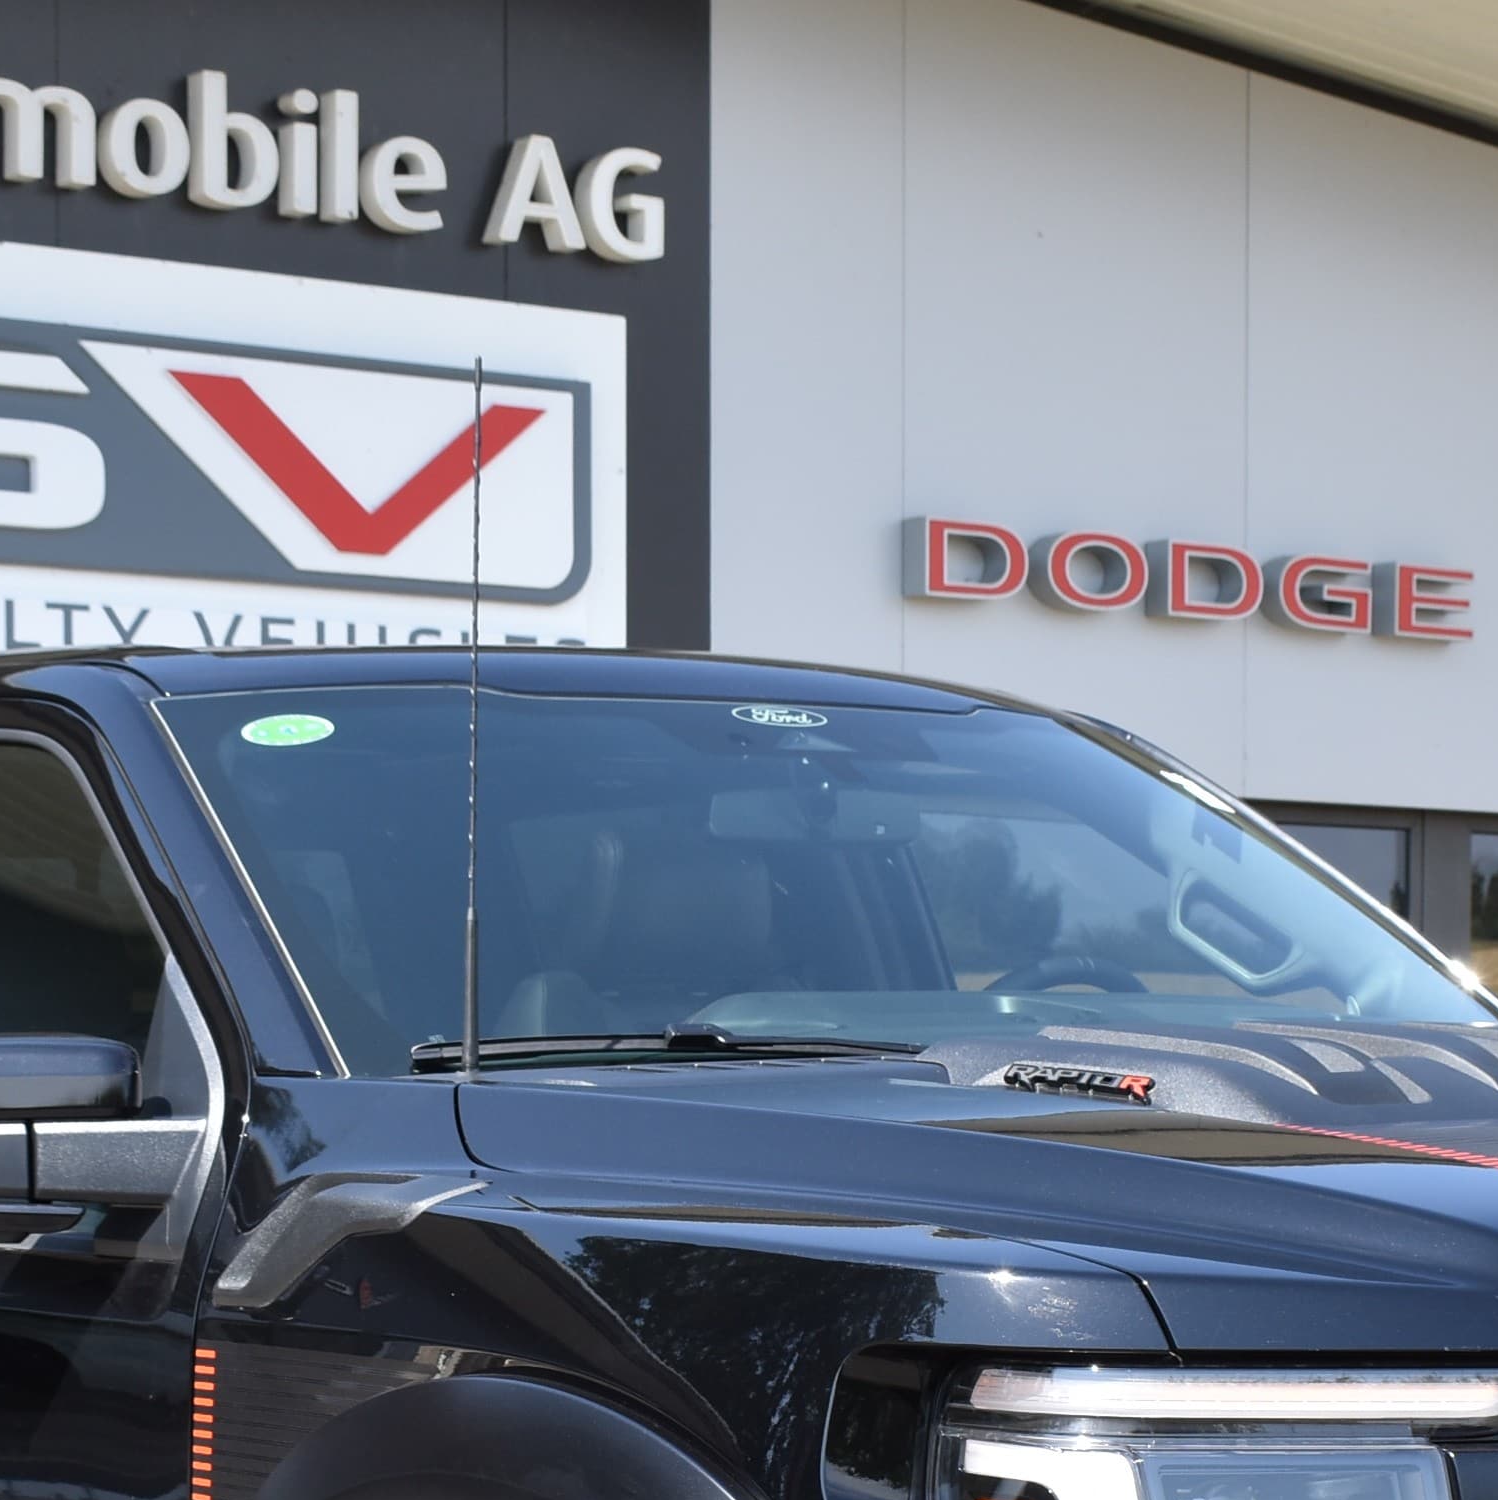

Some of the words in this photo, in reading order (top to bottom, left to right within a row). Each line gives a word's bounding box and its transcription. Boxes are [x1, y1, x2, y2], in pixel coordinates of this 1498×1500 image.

[481, 134, 665, 263] AG
[903, 514, 1475, 640] DODGE
[751, 708, 812, 724] Ford
[1004, 1062, 1155, 1105] RAPTOR
